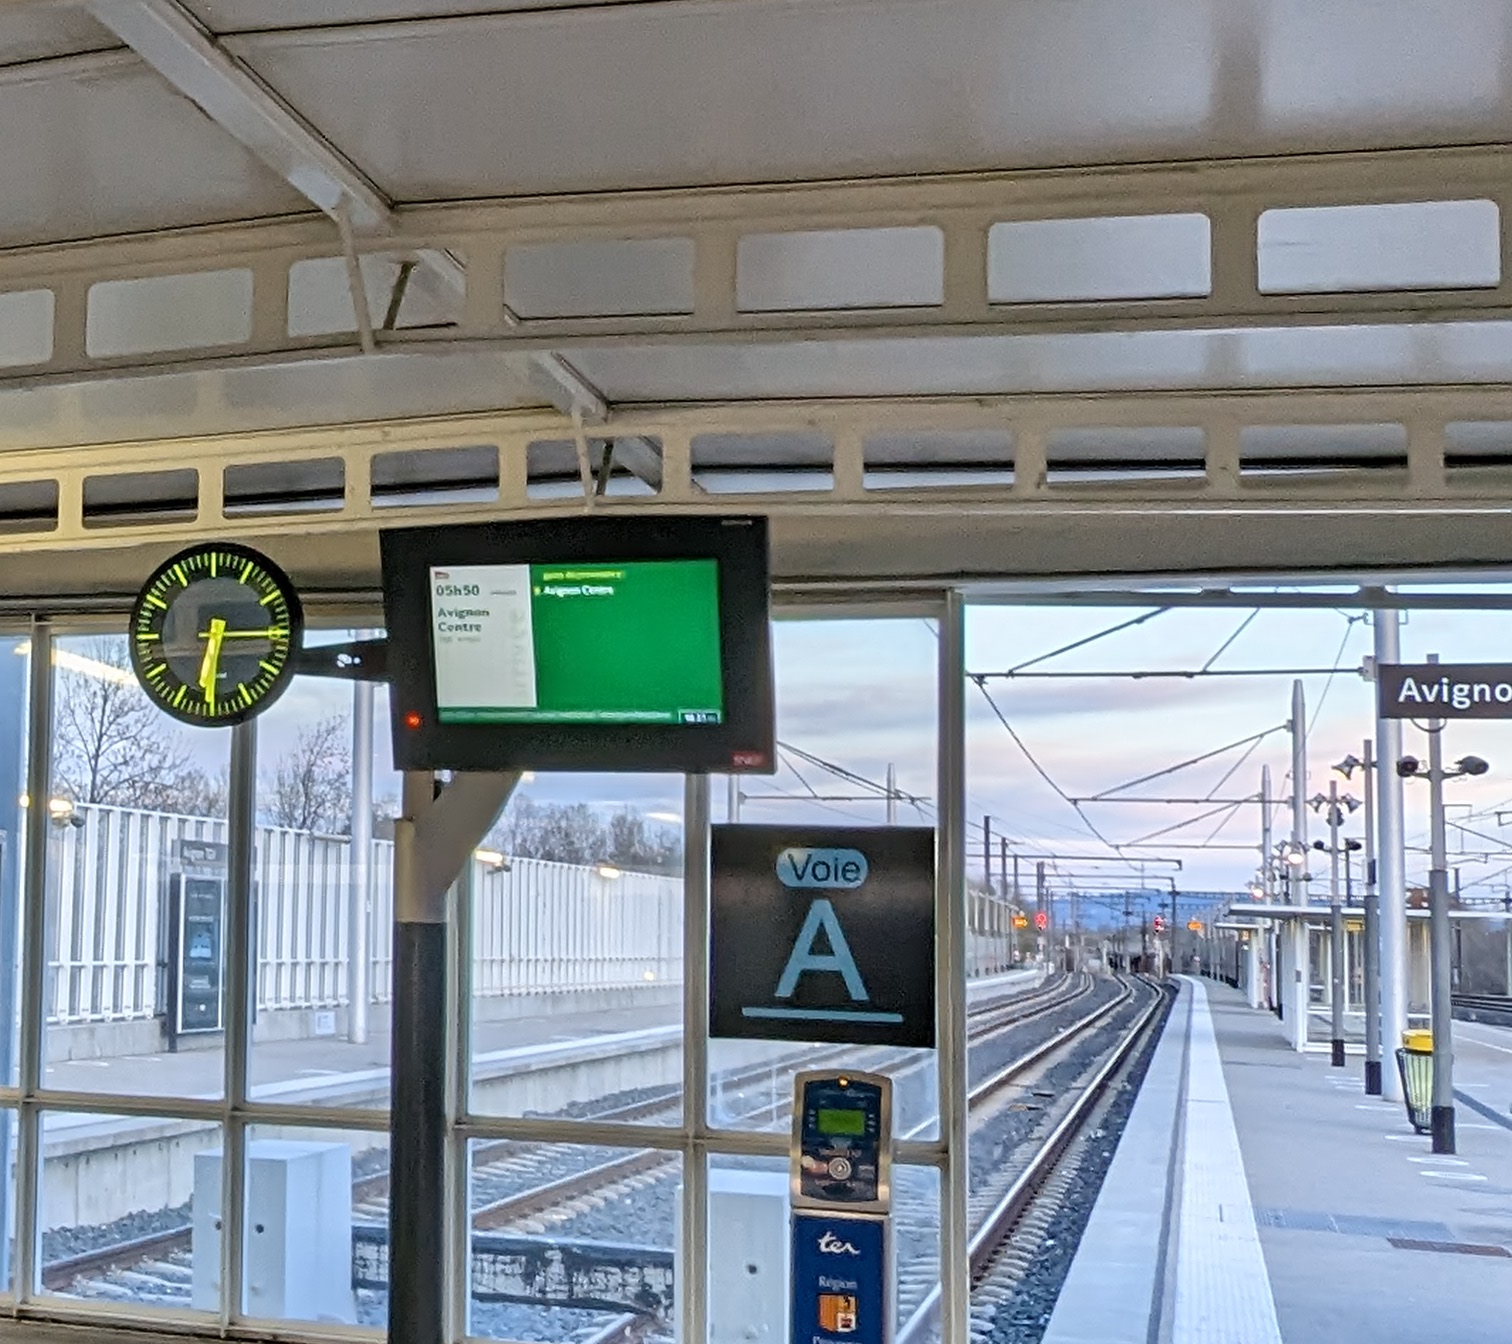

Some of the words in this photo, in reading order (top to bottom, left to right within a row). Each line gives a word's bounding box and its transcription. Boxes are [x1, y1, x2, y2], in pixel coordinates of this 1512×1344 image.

[436, 584, 480, 596] 05h50
[438, 607, 490, 619] Avignon
[438, 622, 482, 632] Centre
[788, 853, 861, 882] Voie
[774, 898, 871, 1002] A
[817, 1230, 861, 1255] ter
